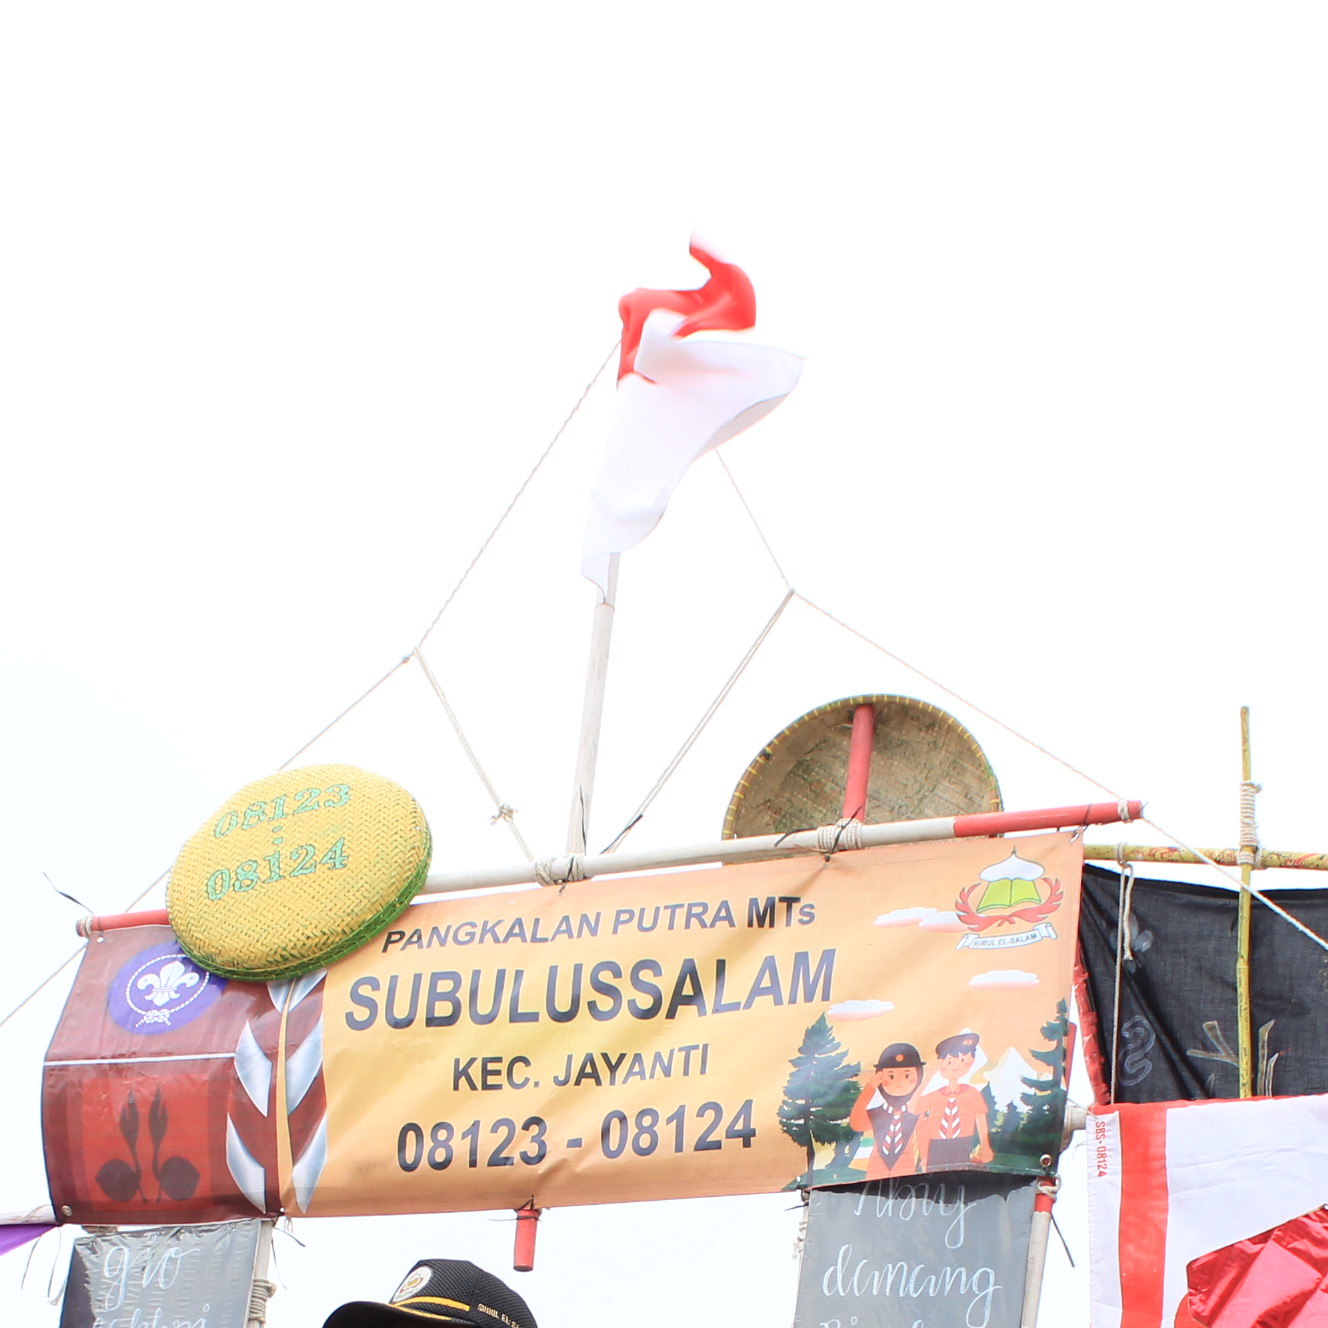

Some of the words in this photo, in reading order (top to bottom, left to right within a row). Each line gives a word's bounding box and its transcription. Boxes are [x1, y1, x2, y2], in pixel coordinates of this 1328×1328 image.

[213, 783, 351, 838] 08123
[206, 837, 349, 901] 08124
[382, 911, 602, 954] PANGKALAN
[612, 899, 736, 936] PUTRA
[746, 896, 817, 929] MTs
[345, 948, 837, 1031] SUBULUSSALAM
[453, 1054, 540, 1092] KEC.
[553, 1043, 710, 1087] JAYANTI
[397, 1115, 548, 1173] 08123
[600, 1099, 757, 1160] 08124
[1095, 1121, 1108, 1178] SBS-08124
